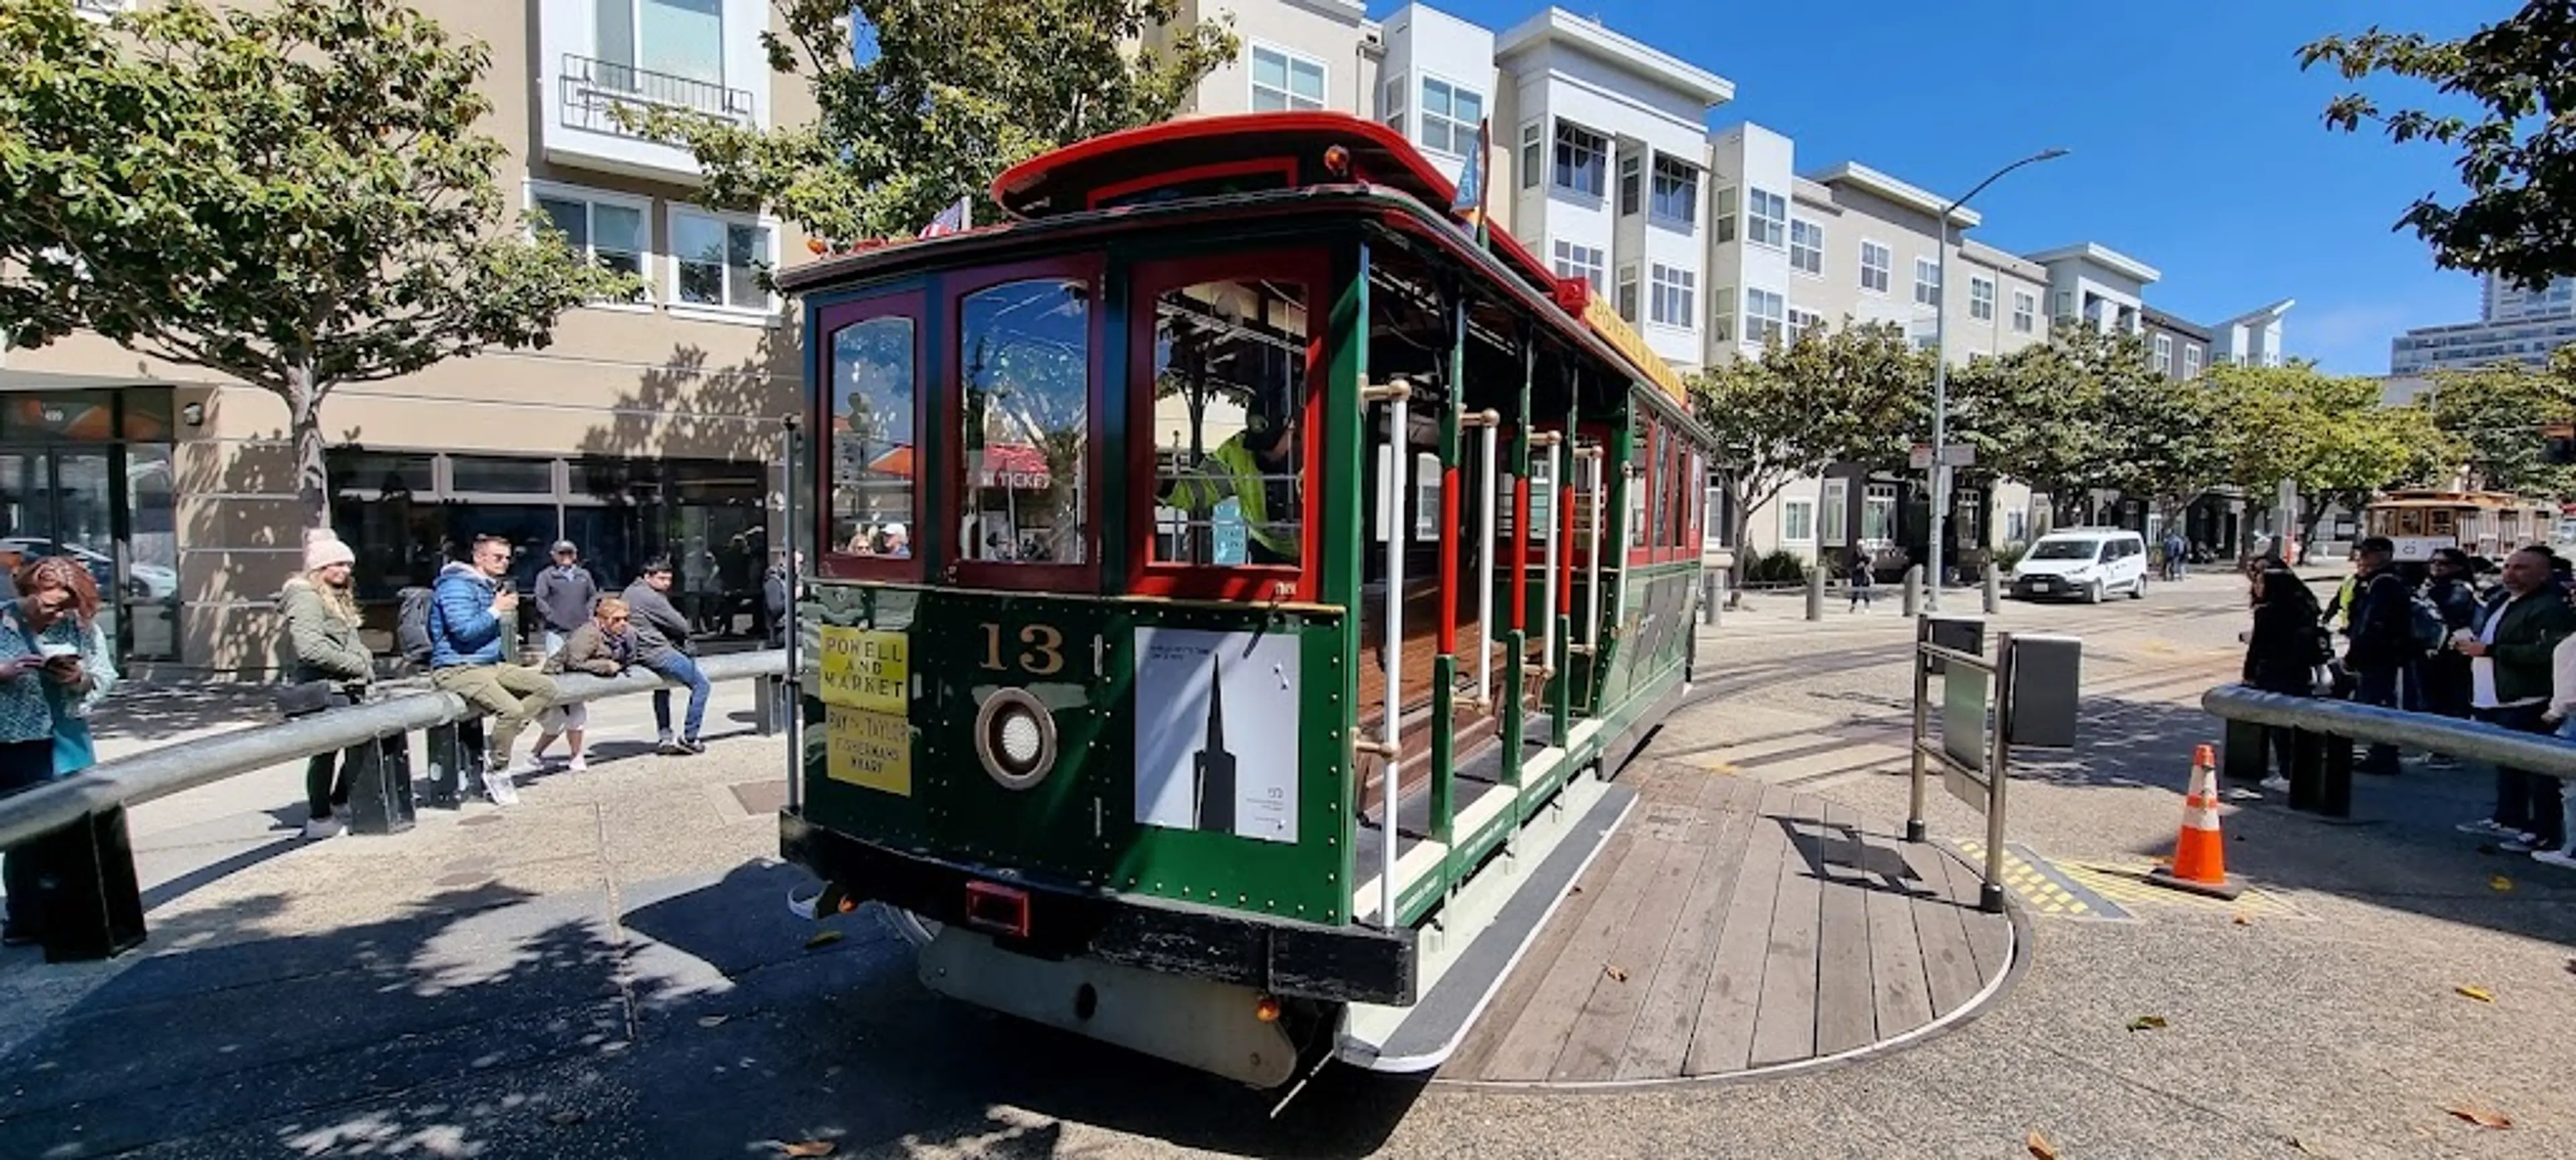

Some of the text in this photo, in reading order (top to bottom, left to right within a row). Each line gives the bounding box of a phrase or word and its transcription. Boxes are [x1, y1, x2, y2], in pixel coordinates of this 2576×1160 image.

[825, 637, 902, 662] POWELL
[978, 623, 1065, 675] 13
[845, 660, 882, 675] AND
[825, 672, 903, 697] MARKET
